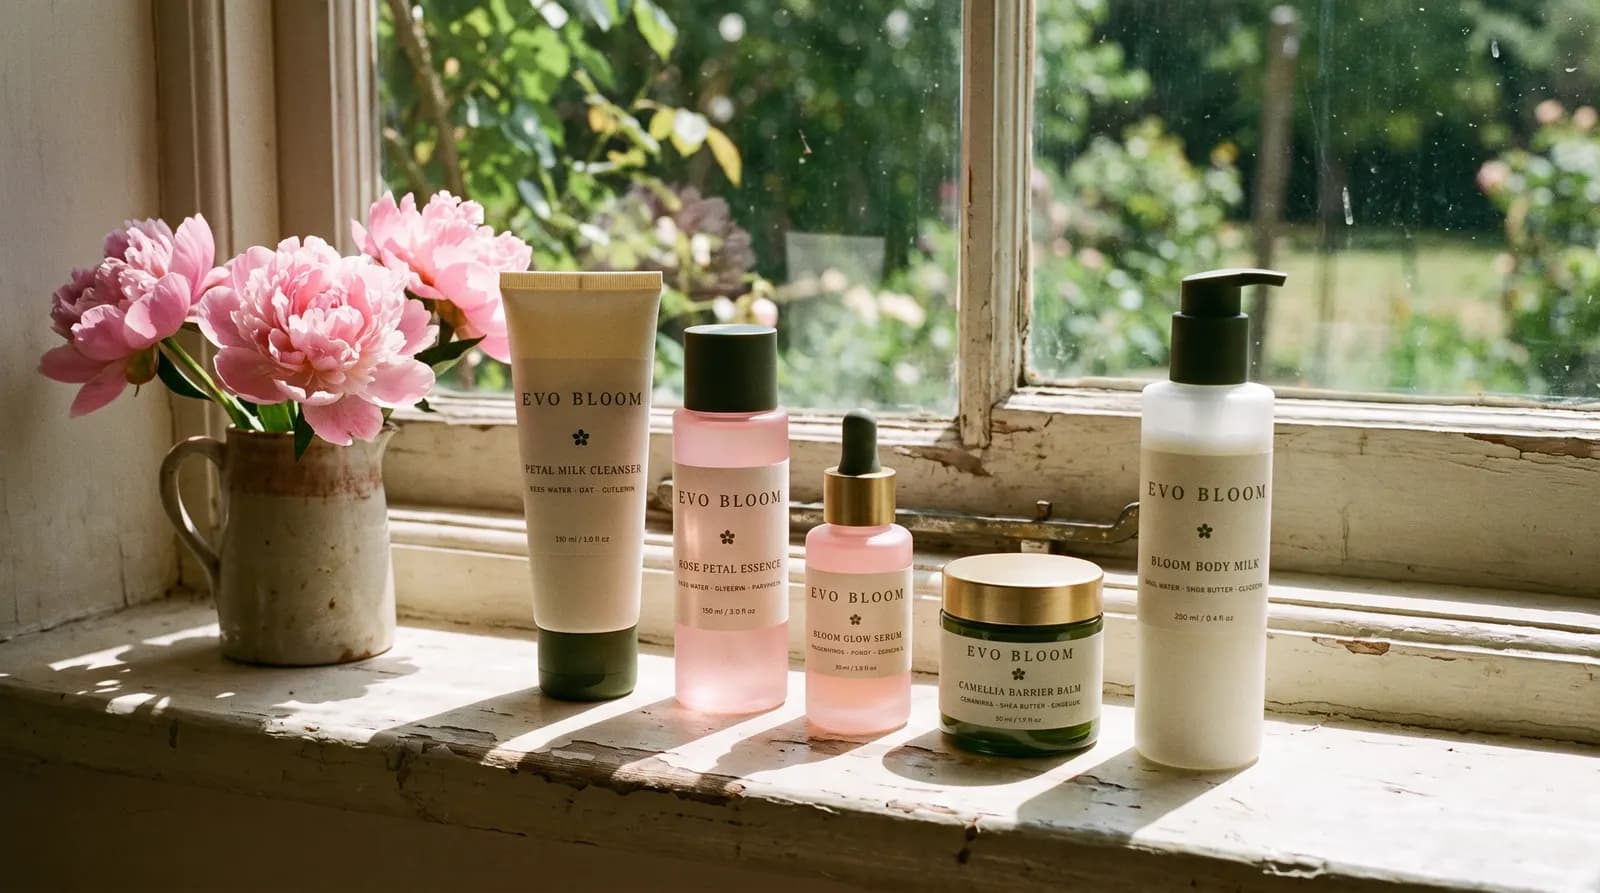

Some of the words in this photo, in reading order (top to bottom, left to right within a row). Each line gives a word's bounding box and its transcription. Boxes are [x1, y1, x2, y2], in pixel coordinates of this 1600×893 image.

[522, 392, 561, 406] EVO
[573, 392, 642, 406] BLOOM
[525, 464, 555, 475] PETAL
[558, 465, 586, 475] MILK
[590, 464, 641, 475] CLEANSER
[679, 490, 709, 507] EVO
[719, 489, 781, 508] BLOOM
[1148, 481, 1185, 501] EVO
[1198, 484, 1265, 502] BLOOM
[679, 559, 700, 572] ROSE
[703, 563, 737, 574] PETAL
[741, 559, 781, 573] ESSENCE
[1151, 555, 1191, 571] BLOOM
[1196, 561, 1230, 572] BODY
[1234, 558, 1260, 571] MILK
[811, 587, 839, 602] EVO
[848, 588, 904, 604] BLOOM
[813, 630, 841, 642] BLOOM
[843, 634, 871, 643] GLOW
[874, 631, 902, 642] SERUM
[967, 645, 1001, 661] EVO
[1011, 648, 1073, 662] BLOOM
[958, 681, 1005, 696] CAMELLIA
[1009, 688, 1054, 697] BARRIER
[1057, 684, 1080, 695] BALM
